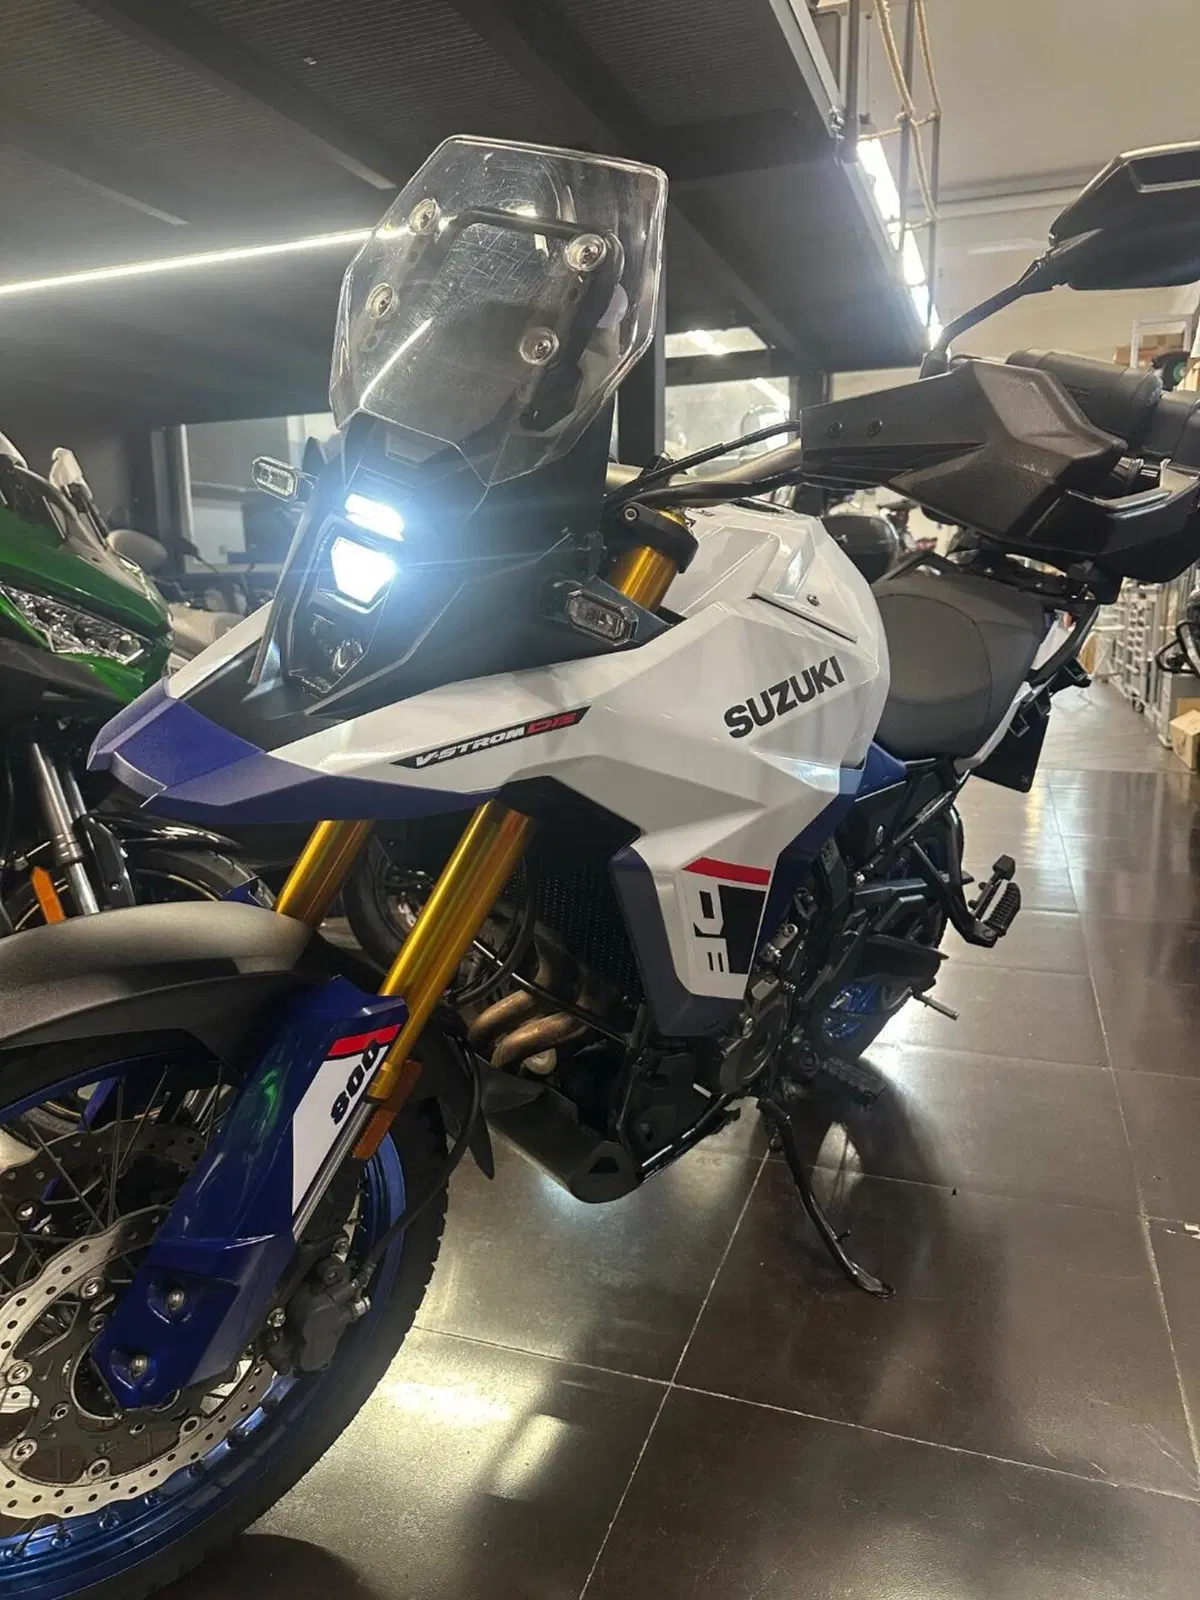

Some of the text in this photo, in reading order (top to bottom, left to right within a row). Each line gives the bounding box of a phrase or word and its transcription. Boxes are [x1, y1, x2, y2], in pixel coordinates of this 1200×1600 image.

[724, 655, 845, 738] SUZUKI
[416, 727, 525, 767] V-STROM
[330, 1039, 381, 1126] 800
